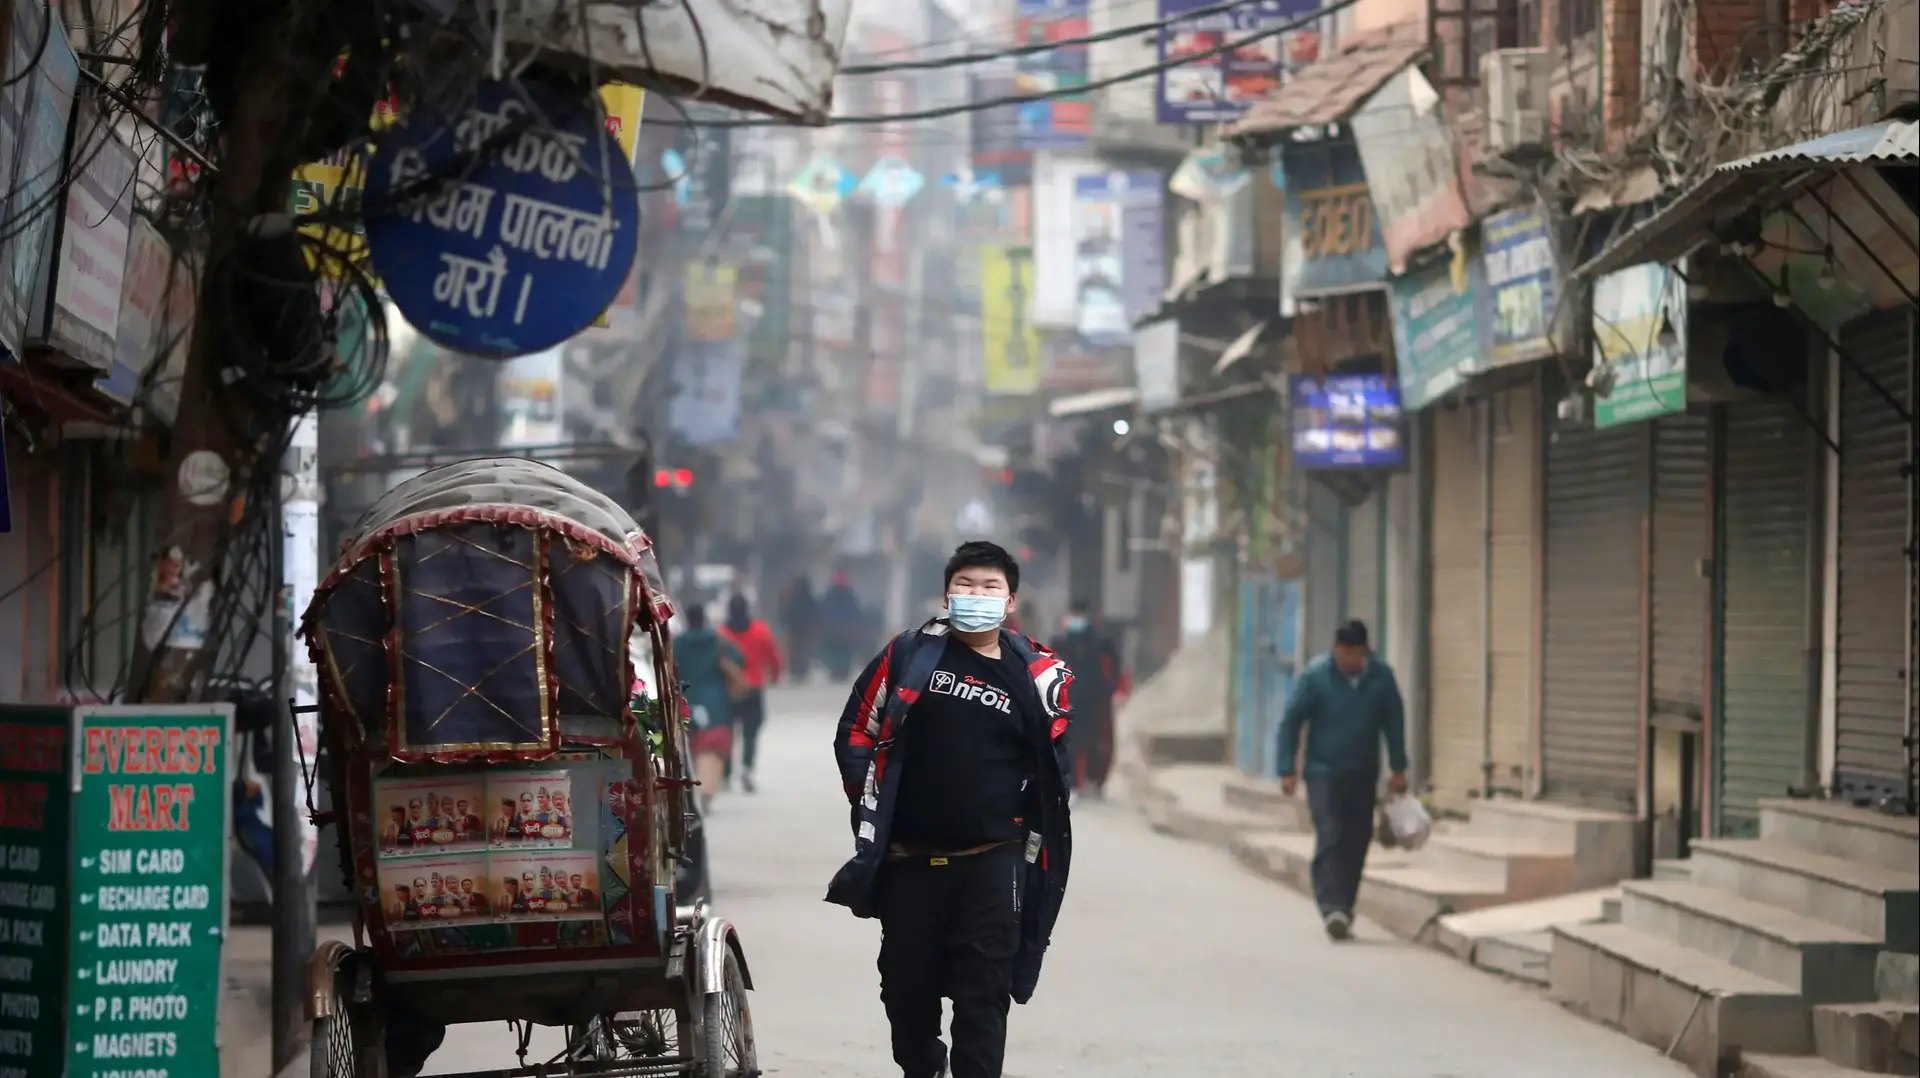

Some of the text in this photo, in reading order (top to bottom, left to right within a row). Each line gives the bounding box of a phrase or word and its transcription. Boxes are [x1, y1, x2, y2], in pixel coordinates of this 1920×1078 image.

[83, 726, 221, 774] EVEREST
[107, 784, 195, 831] MART
[99, 848, 184, 875] SIM CARD
[98, 884, 209, 911] RECHARGE CARD
[97, 921, 192, 948] DATA PACK
[95, 957, 178, 985] LAUNDRY
[128, 994, 188, 1021] PHOTO
[93, 1031, 177, 1059] MAGNETS
